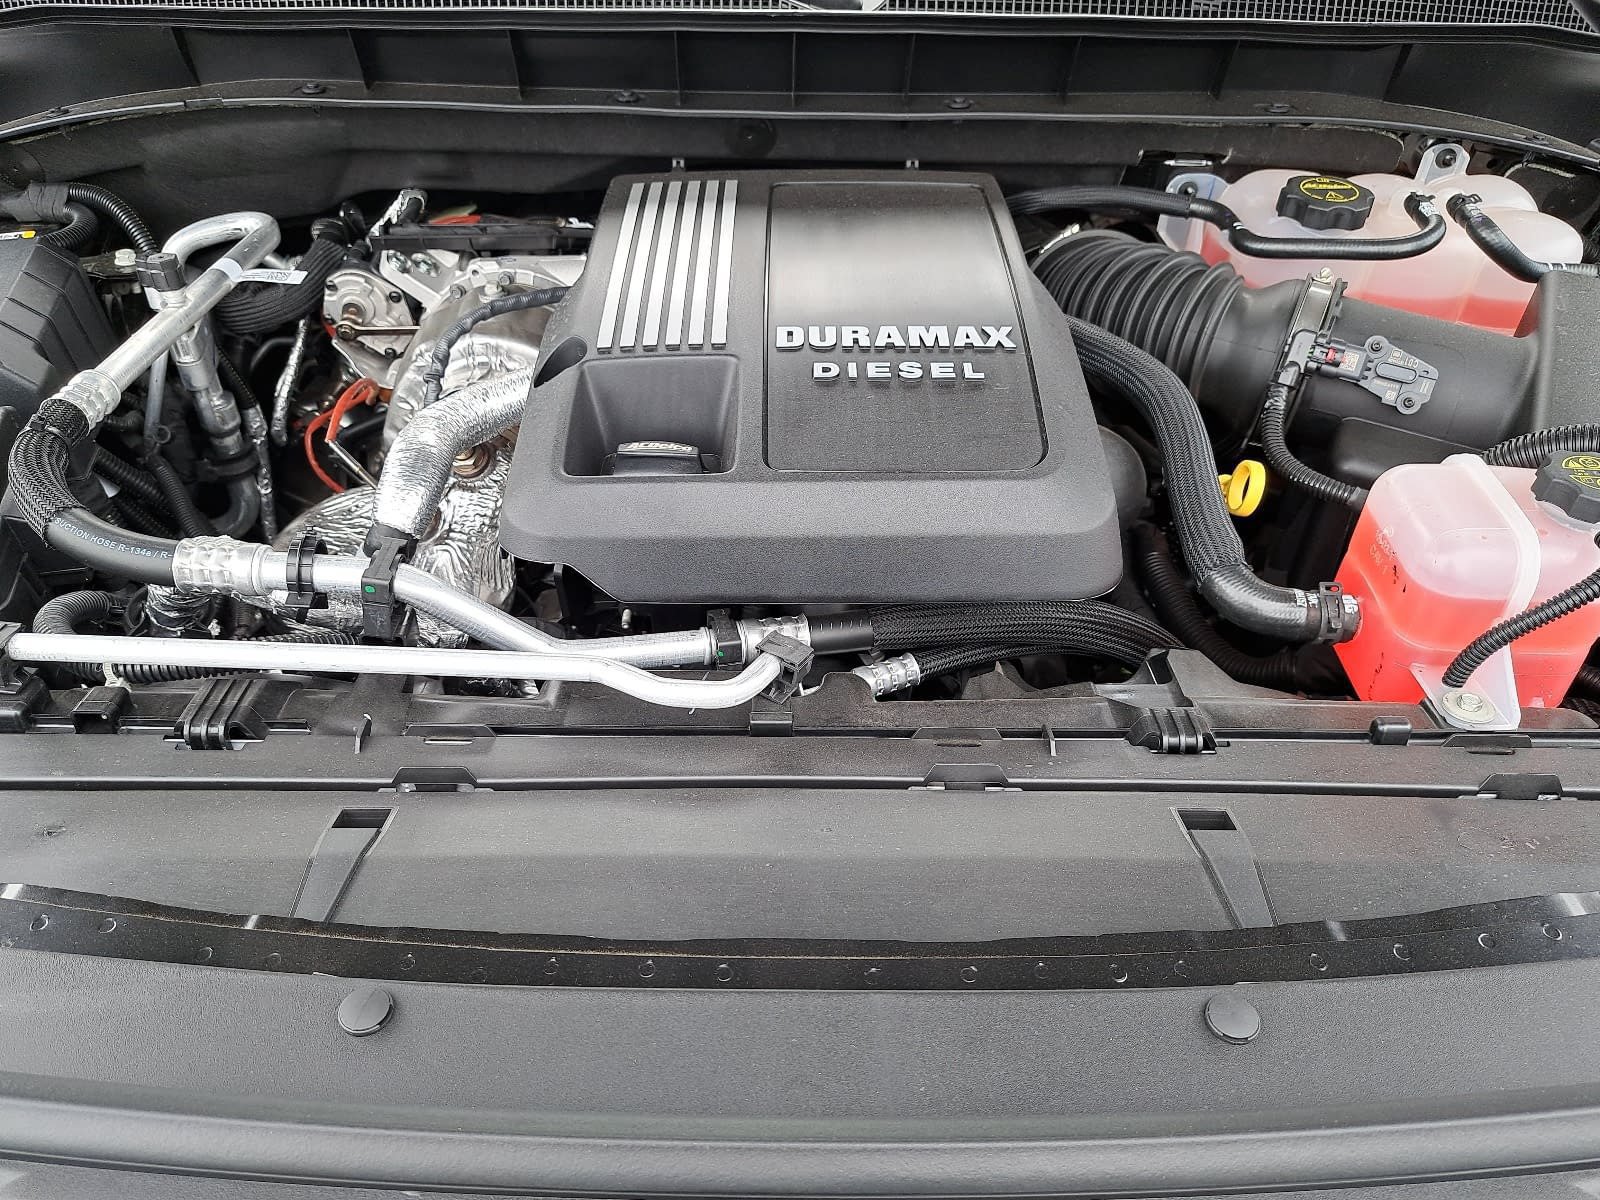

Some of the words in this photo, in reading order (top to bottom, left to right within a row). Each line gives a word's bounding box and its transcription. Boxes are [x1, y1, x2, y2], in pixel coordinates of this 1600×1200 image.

[775, 325, 1017, 351] DURAMAX
[812, 361, 986, 381] DIESEL
[54, 517, 89, 540] SUCTION
[90, 535, 117, 549] HOSE
[117, 543, 152, 557] R-134a
